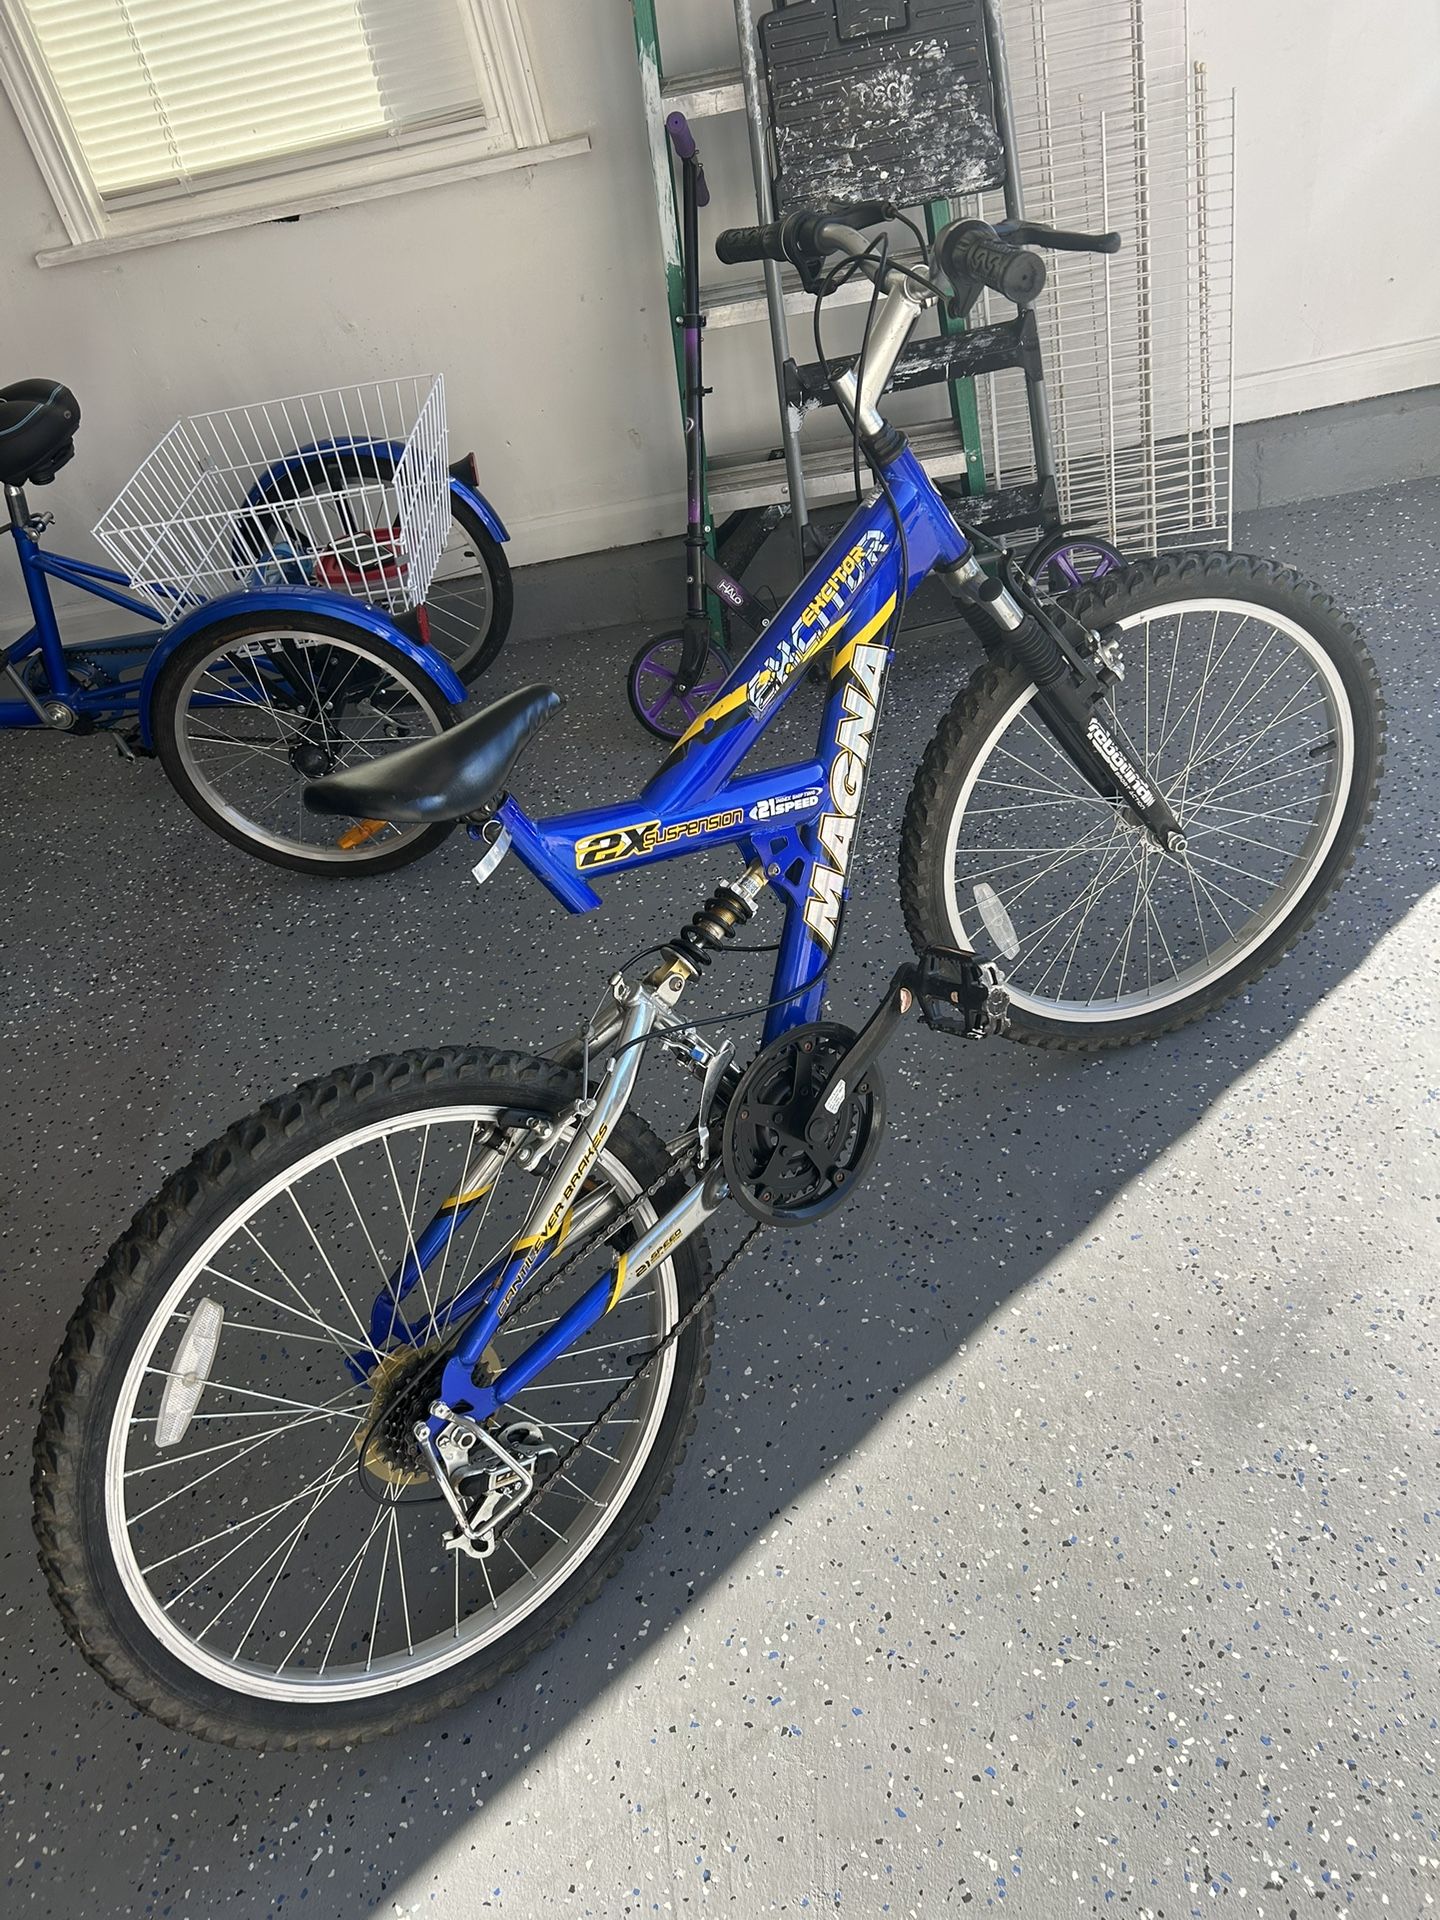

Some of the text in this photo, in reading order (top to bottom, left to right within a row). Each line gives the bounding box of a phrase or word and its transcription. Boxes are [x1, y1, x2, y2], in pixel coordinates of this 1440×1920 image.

[717, 579, 743, 606] HALO
[801, 543, 867, 627] EXCITOR
[756, 796, 819, 818] 21 SPEED
[803, 643, 889, 949] MAGNA
[578, 822, 658, 866] 2X
[496, 1122, 608, 1318] CANTILEVER BRAKES
[649, 1227, 682, 1260] SPEED
